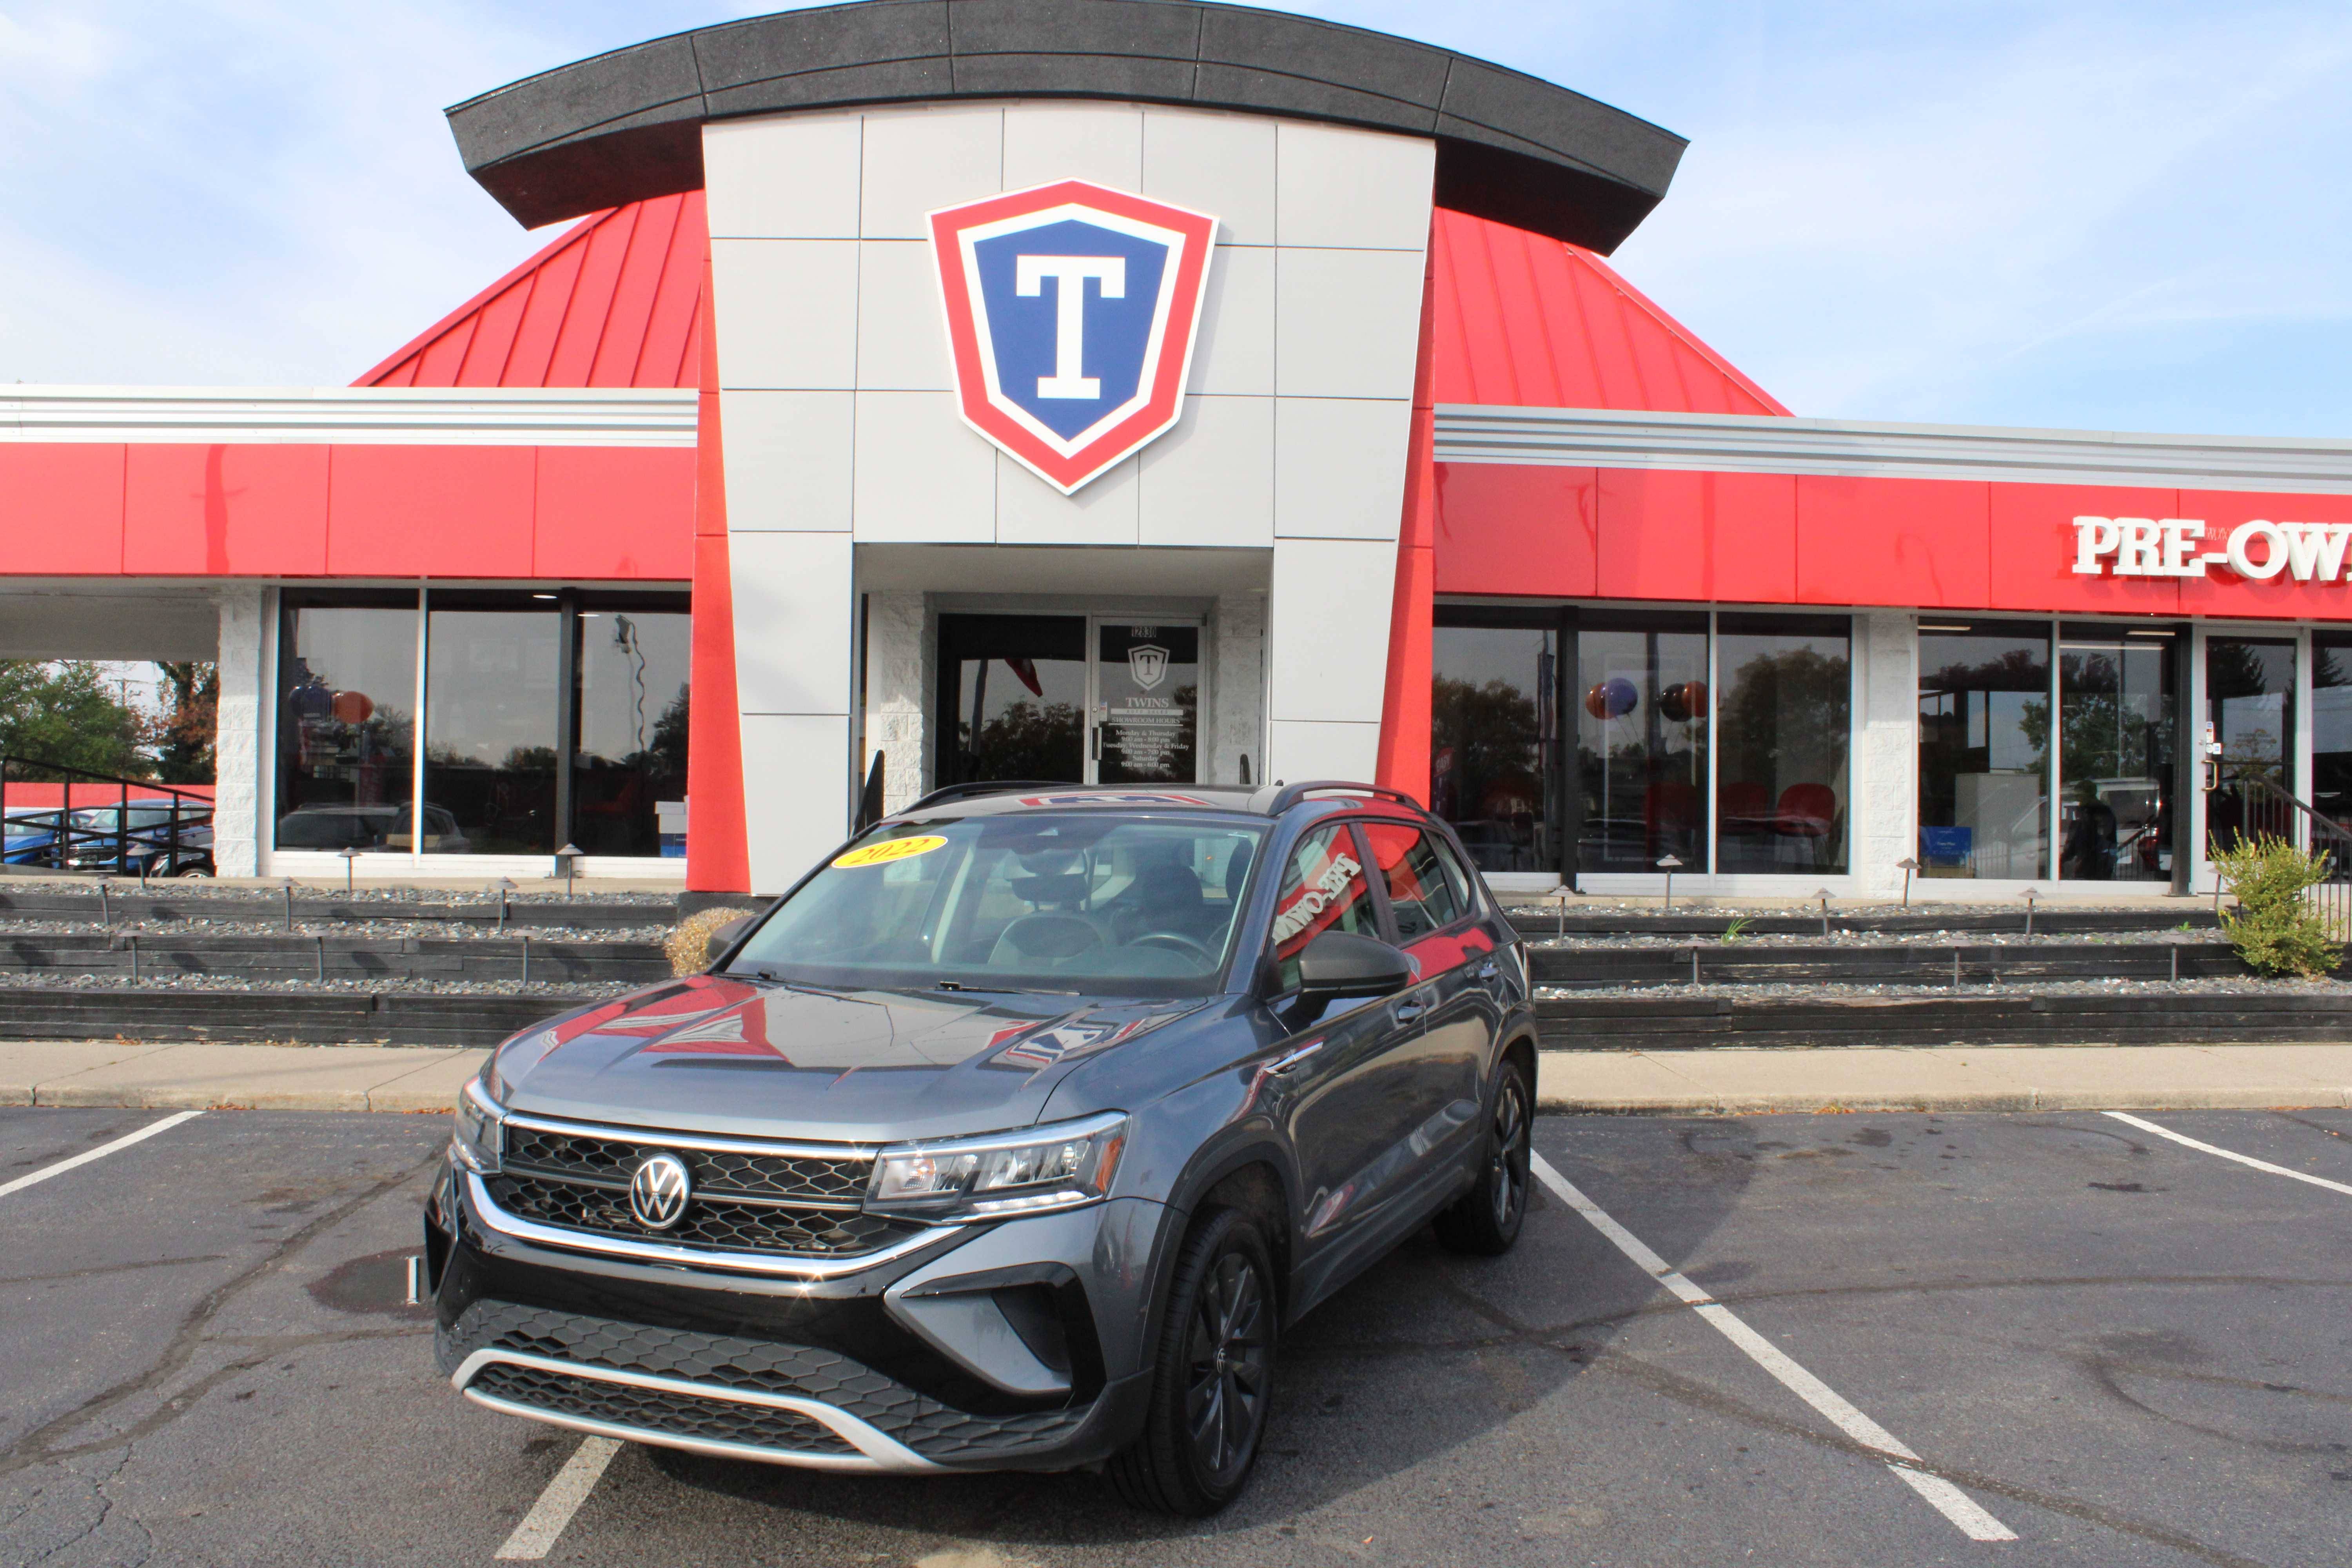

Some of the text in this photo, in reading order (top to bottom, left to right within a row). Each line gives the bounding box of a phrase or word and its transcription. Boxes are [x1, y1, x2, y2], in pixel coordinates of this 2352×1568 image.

[1016, 255, 1125, 399] T
[2072, 515, 2352, 581] PRE-OW
[1140, 655, 1158, 675] T
[1125, 698, 1169, 708] TWINS
[850, 838, 930, 864] 2022
